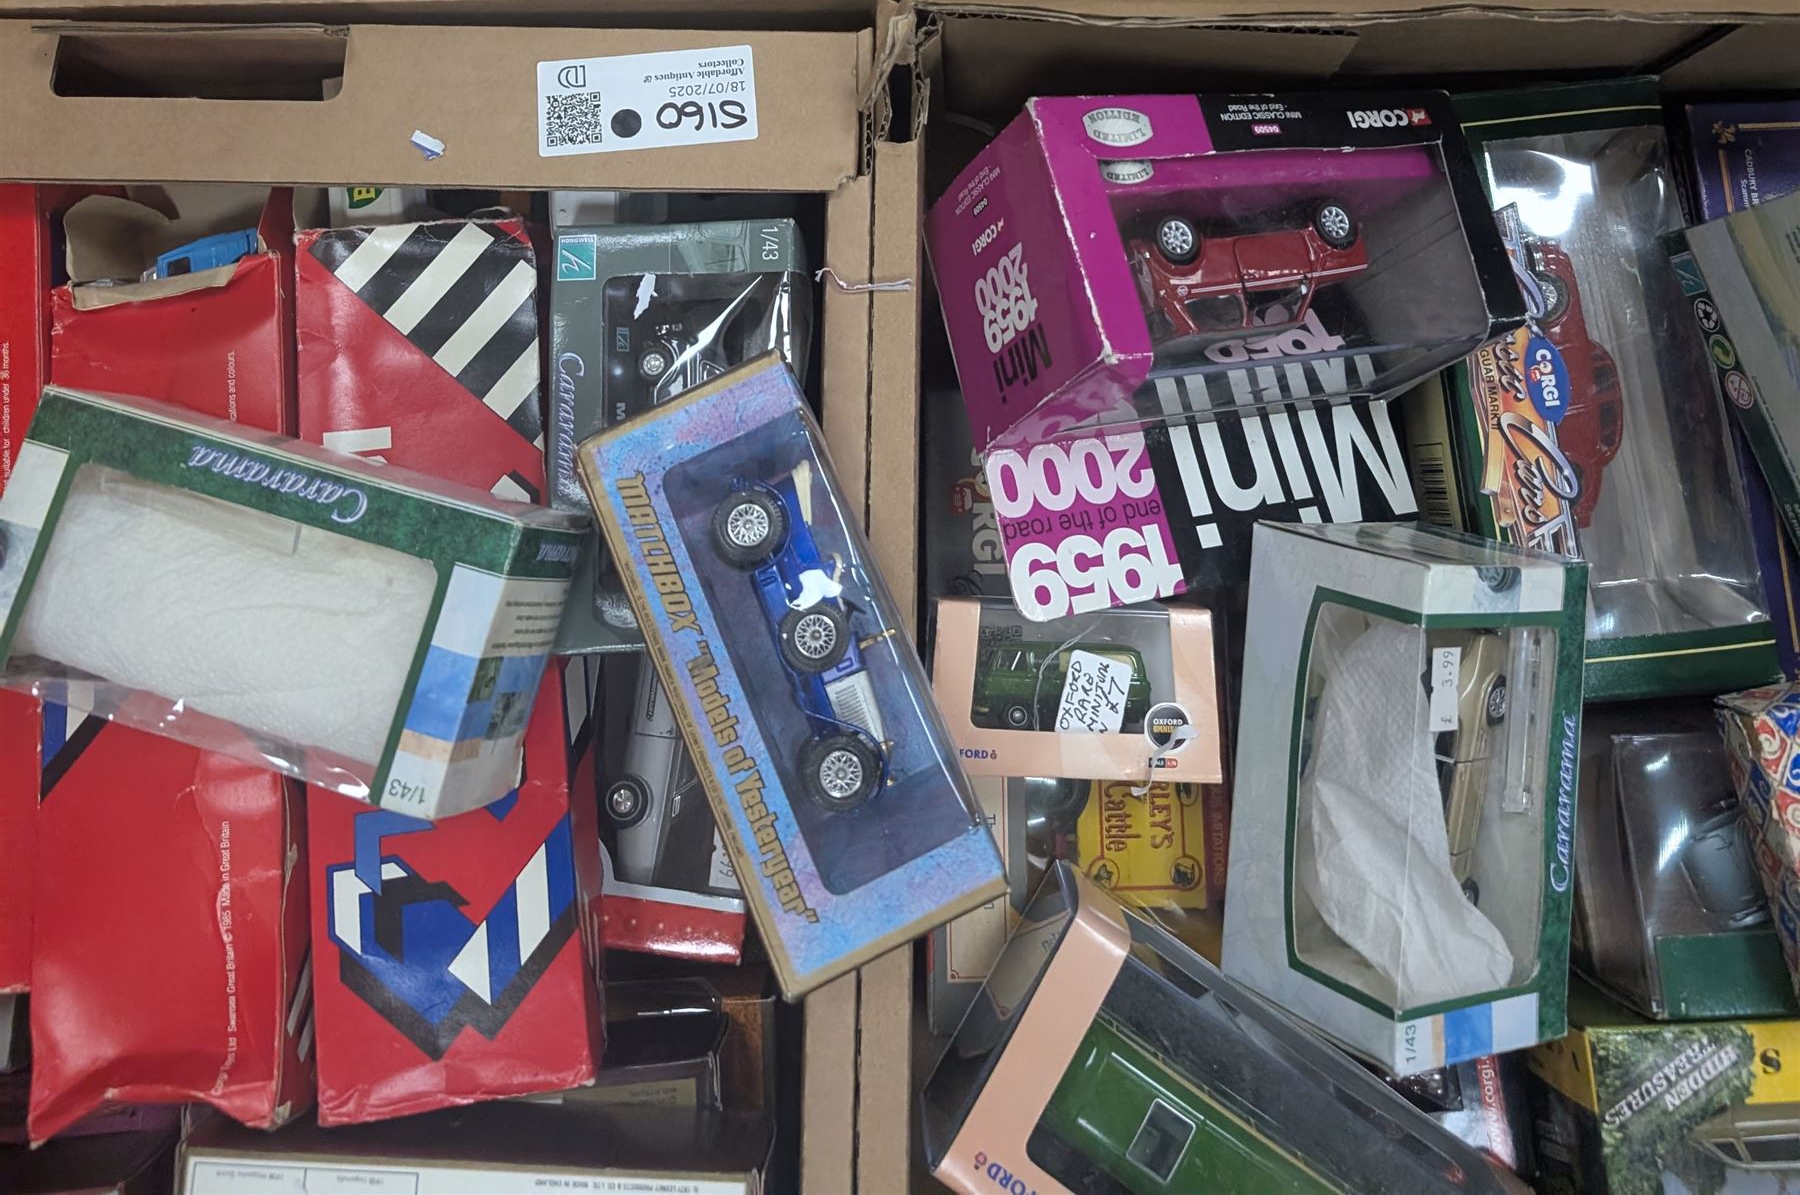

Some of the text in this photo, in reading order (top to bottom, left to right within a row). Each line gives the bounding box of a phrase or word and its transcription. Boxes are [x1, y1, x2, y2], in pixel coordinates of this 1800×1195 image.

[654, 70, 695, 82] Antiques
[696, 67, 746, 79] Affordable
[698, 58, 745, 69] Collectors
[668, 80, 746, 98] 18/07/2025
[1088, 107, 1142, 124] EDITION
[1221, 111, 1302, 122] MINI CLASSIC EDITION
[1228, 104, 1246, 113] Road
[1269, 104, 1283, 112] End
[1347, 109, 1410, 129] CORGI
[1093, 126, 1148, 145] LIMITED
[1254, 124, 1281, 134] 04509
[761, 226, 780, 261] 1/43
[971, 224, 998, 256] CORGI
[974, 241, 1028, 316] 2000
[983, 279, 1038, 354] 1959
[993, 321, 1052, 404] Mini
[1534, 349, 1561, 408] CORGI
[1486, 387, 1499, 421] MARK
[188, 444, 369, 524] Cararama
[986, 433, 1157, 518] 2000
[1169, 400, 1418, 549] Mini
[1003, 498, 1161, 543] end of the road
[1009, 523, 1187, 623] 1959
[1440, 649, 1456, 689] 3.99
[1059, 660, 1083, 731] OXFORD
[1152, 718, 1184, 726] OXFORD
[723, 742, 756, 778] of
[387, 777, 426, 803] 1/43
[1550, 712, 1577, 894] Cararama
[219, 820, 230, 850] Britain
[220, 849, 230, 873] Great
[221, 883, 231, 907] Made
[222, 909, 232, 931] 1985
[225, 942, 236, 970] Britain
[226, 970, 235, 994] Great
[227, 994, 236, 1033] Swansea
[229, 1035, 237, 1052] Ltd
[1404, 1022, 1417, 1065] 1/43
[1604, 1035, 1717, 1130] TREASURES
[1664, 1043, 1739, 1113] HIDDEN
